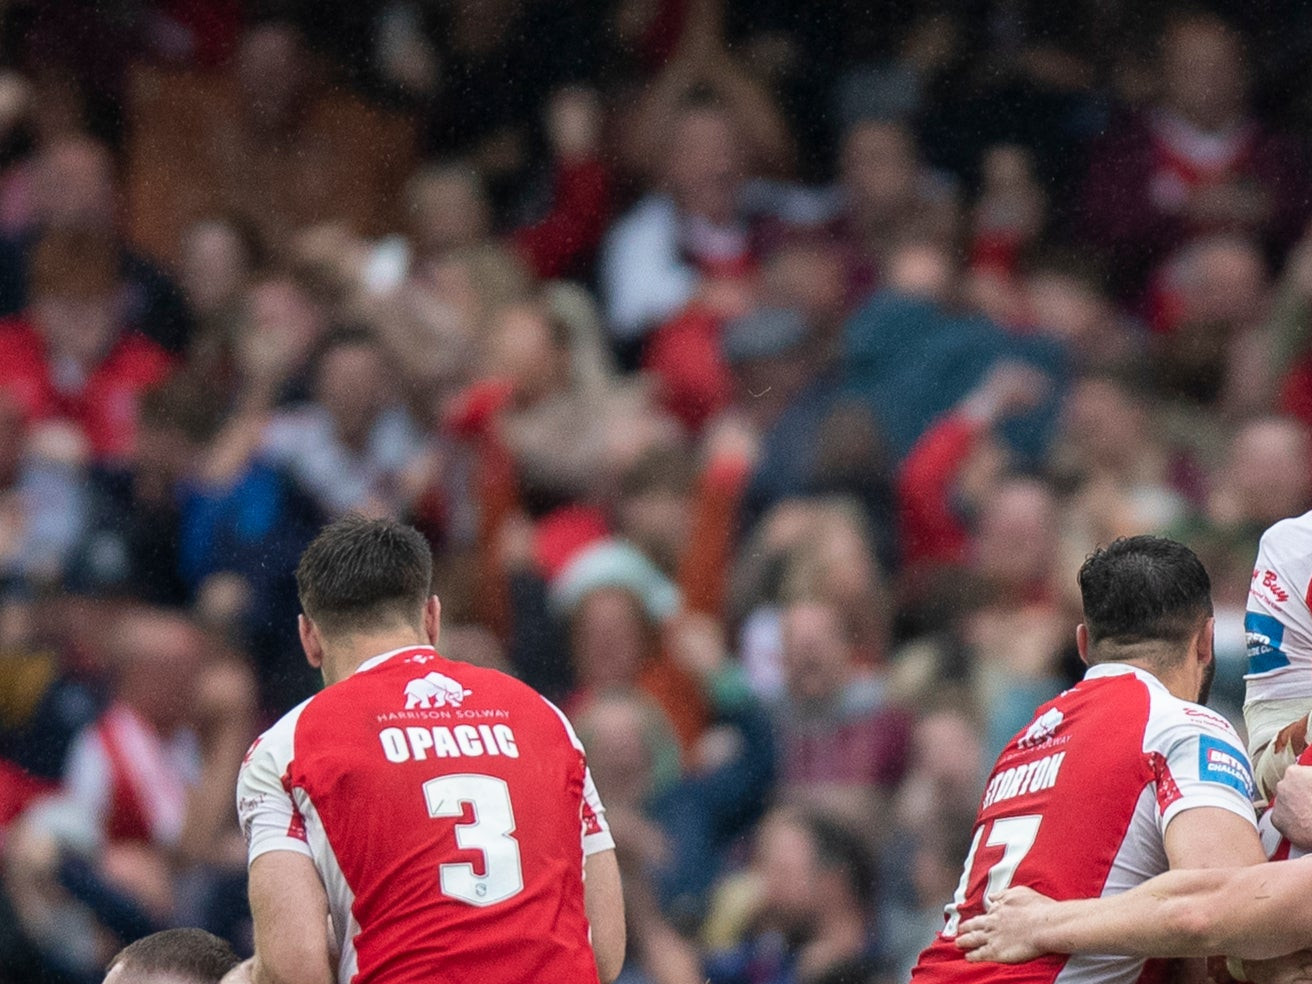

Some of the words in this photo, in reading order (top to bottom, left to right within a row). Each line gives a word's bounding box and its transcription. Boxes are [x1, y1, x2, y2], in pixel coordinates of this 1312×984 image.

[377, 711, 451, 722] HARRISON
[456, 709, 510, 719] SOLWAY
[379, 724, 520, 763] OPACIC
[422, 774, 524, 908] 3
[942, 814, 1043, 937] 17
